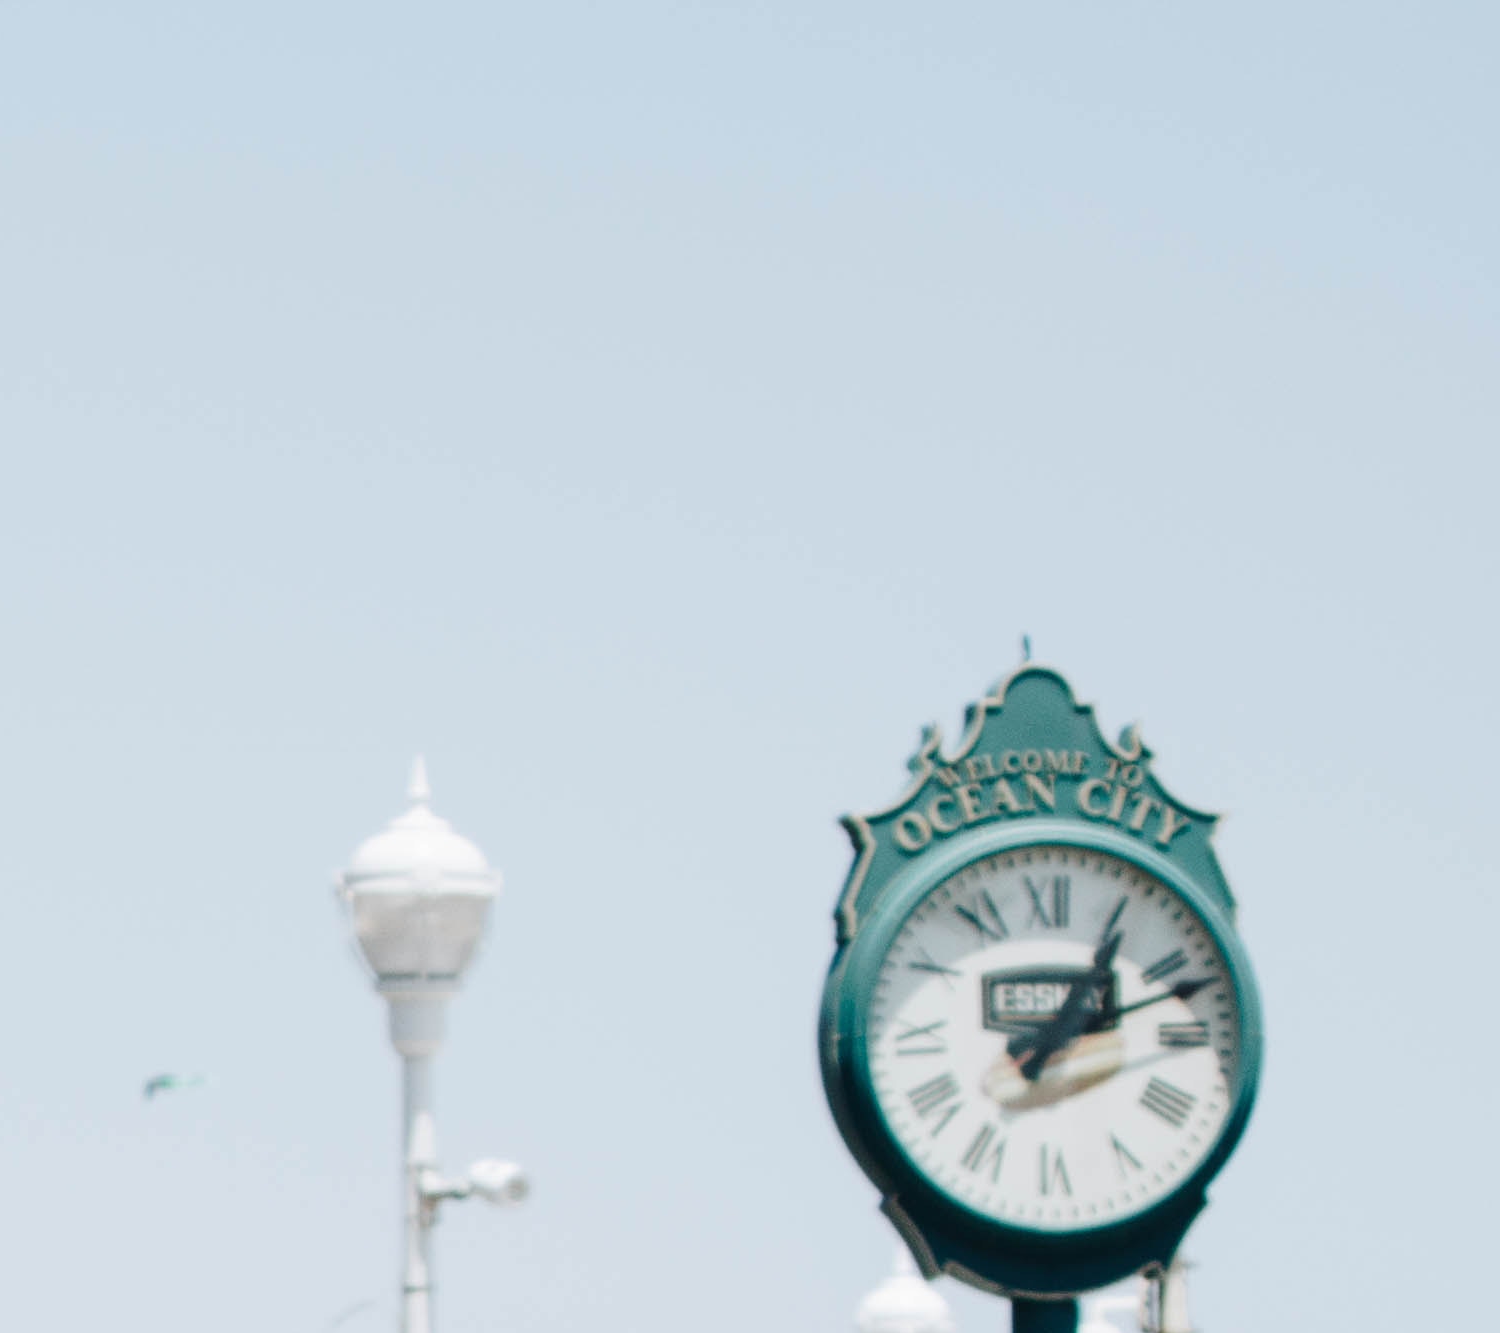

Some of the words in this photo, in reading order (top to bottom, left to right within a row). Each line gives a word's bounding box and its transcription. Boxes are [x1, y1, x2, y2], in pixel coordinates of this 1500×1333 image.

[937, 750, 1090, 786] WELCOME
[1106, 757, 1144, 786] TO
[893, 774, 1056, 850] OCEAN
[1077, 779, 1190, 845] CITY
